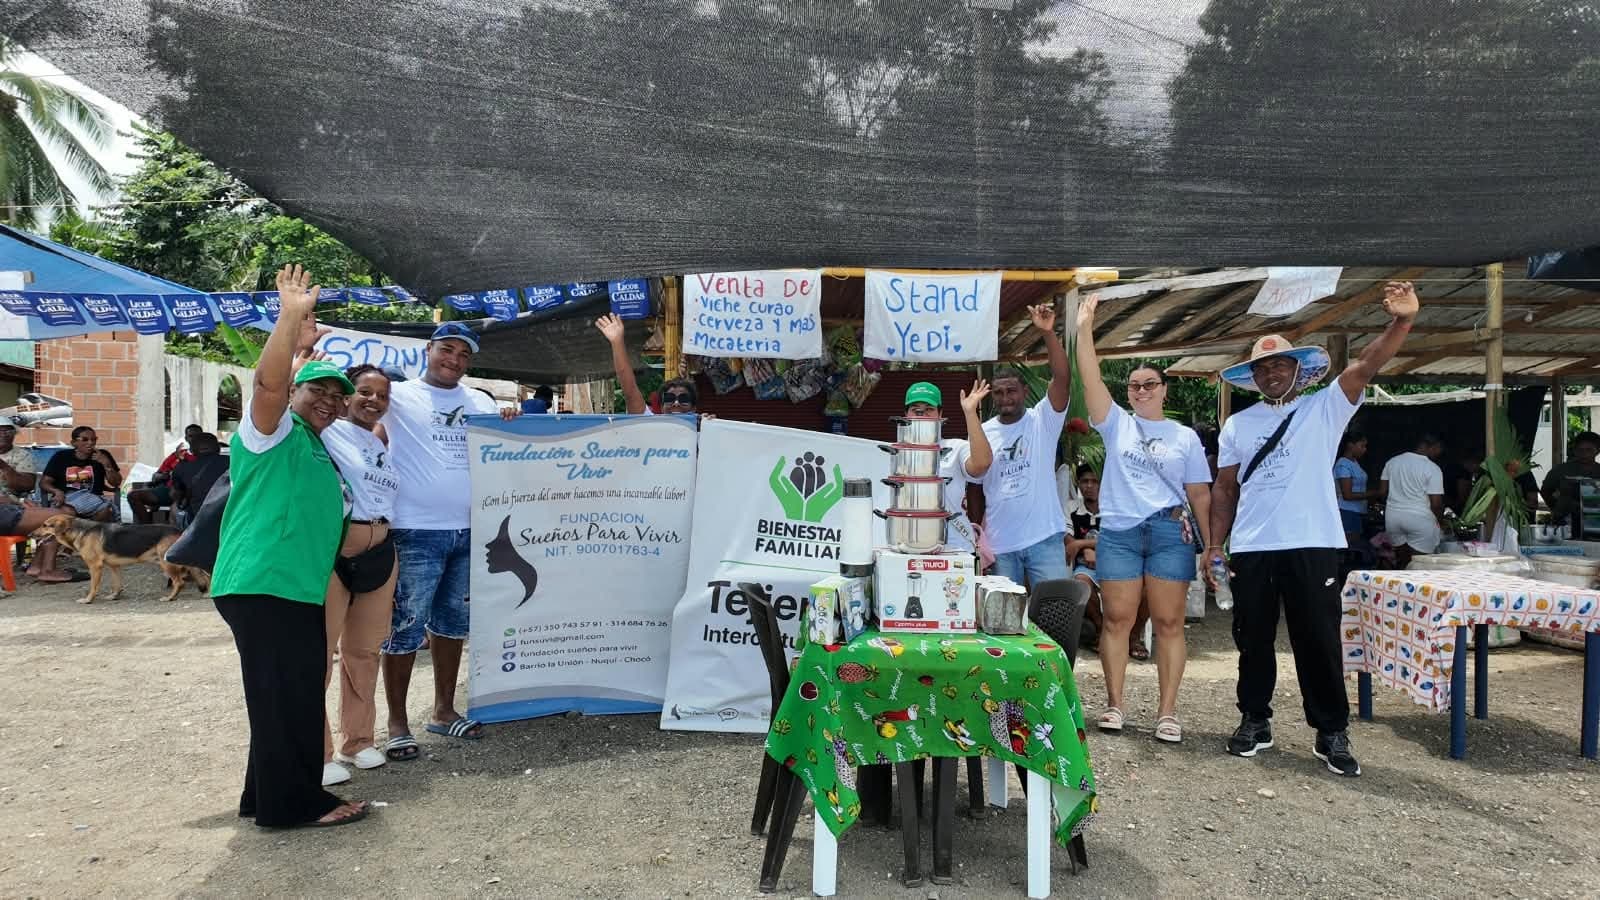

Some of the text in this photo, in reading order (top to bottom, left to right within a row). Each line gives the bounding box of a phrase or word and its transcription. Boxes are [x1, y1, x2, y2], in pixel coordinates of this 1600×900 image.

[697, 273, 764, 298] Venta
[611, 292, 645, 302] CALDAS
[885, 278, 978, 314] Stand
[479, 443, 576, 464] Fundación
[580, 441, 641, 460] Sueños
[643, 447, 690, 465] para
[556, 463, 613, 480] Vivir
[538, 487, 551, 501] del
[560, 512, 644, 524] FUNDACION
[517, 522, 682, 547] Sueños Para Vivir
[576, 544, 660, 556] 900701763-4
[520, 648, 565, 658] fundación
[567, 646, 598, 655] sueños
[520, 663, 546, 671] Barrio
